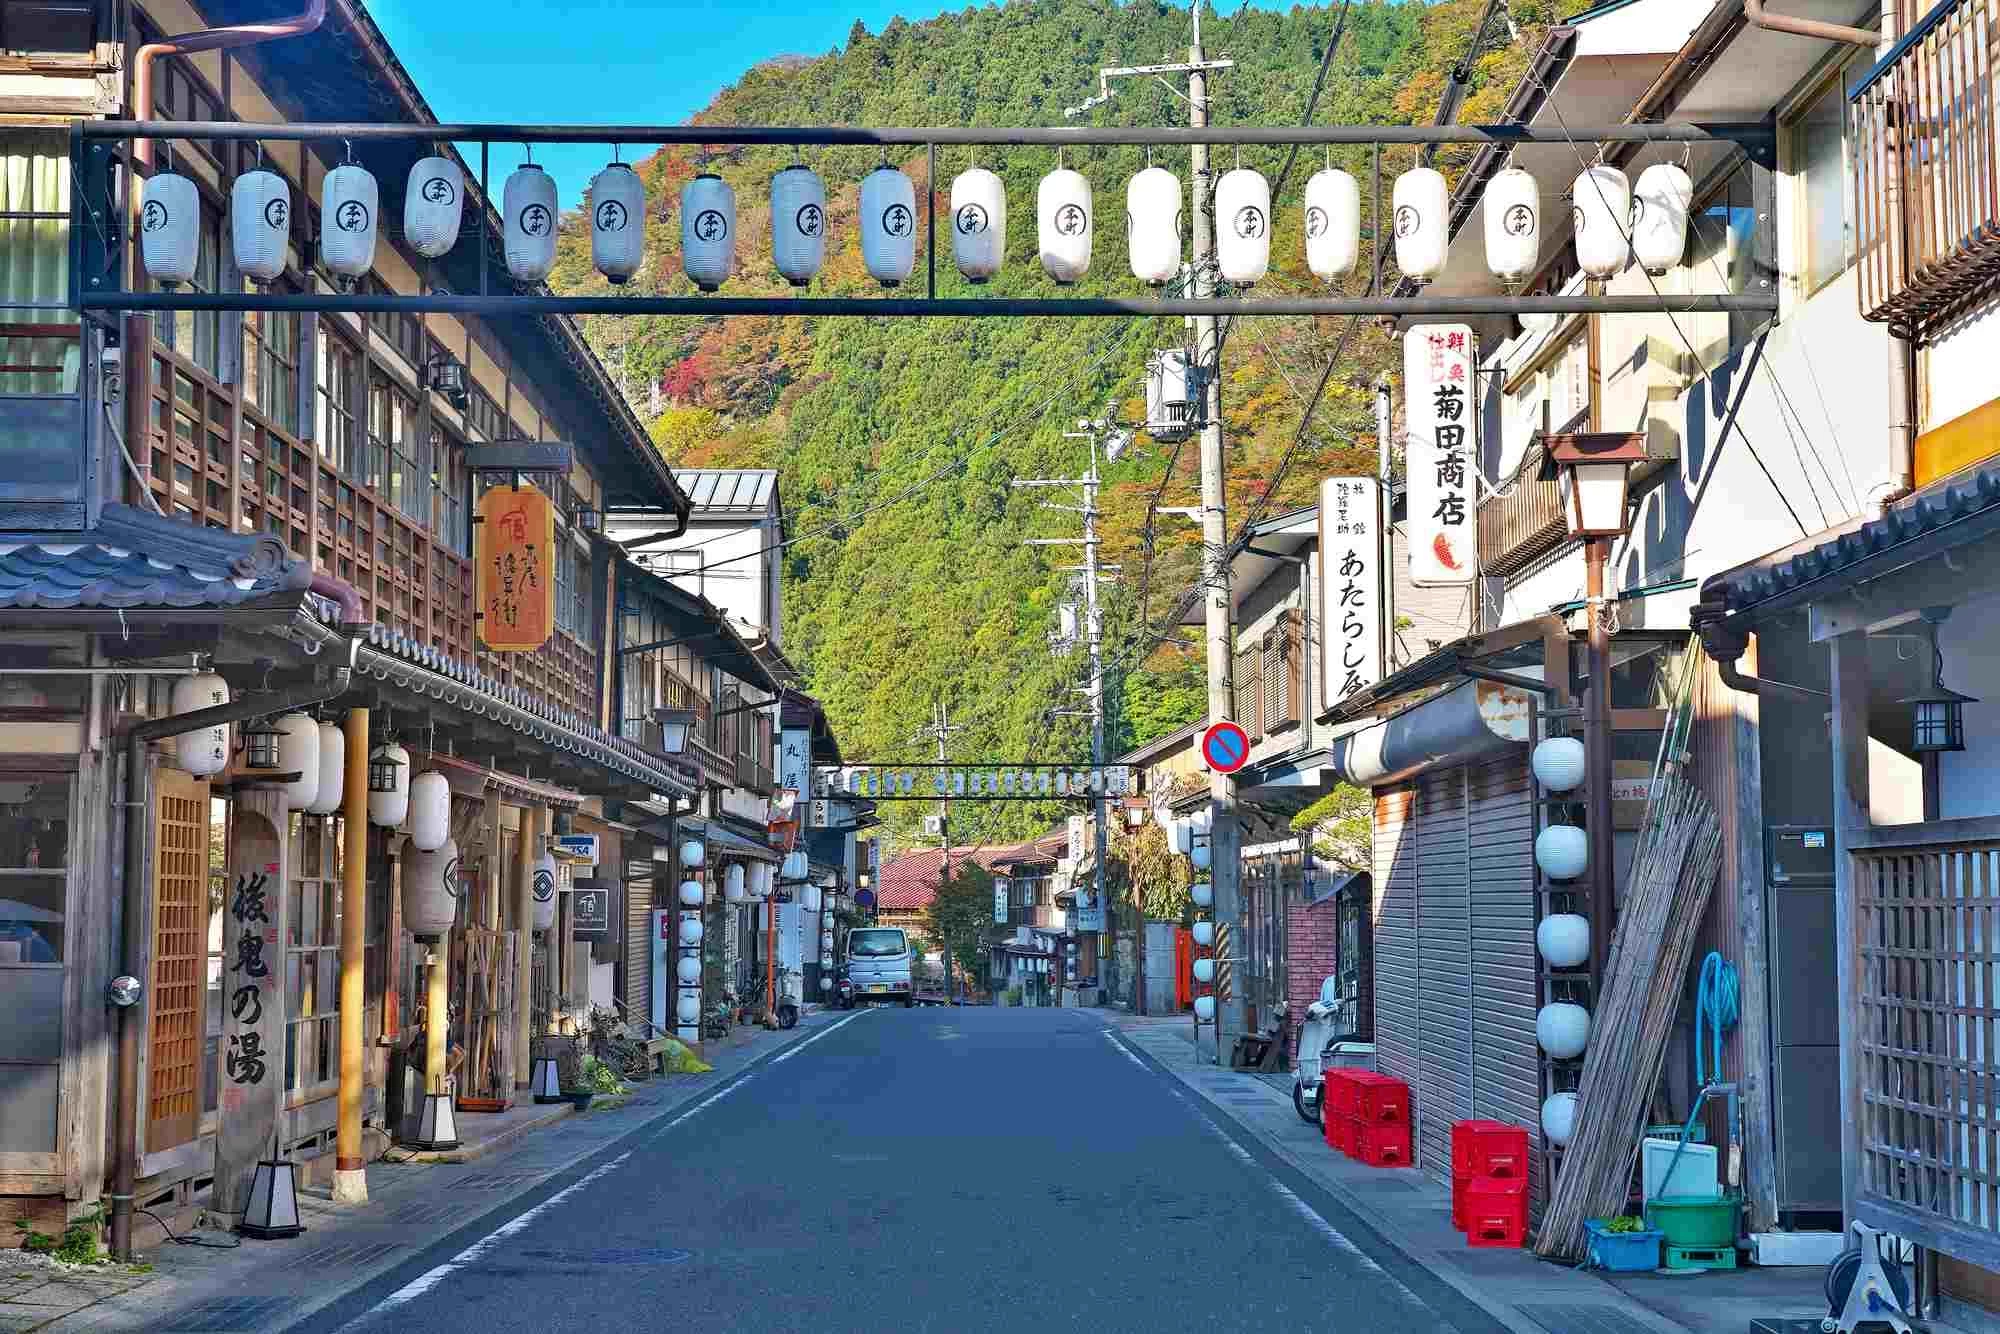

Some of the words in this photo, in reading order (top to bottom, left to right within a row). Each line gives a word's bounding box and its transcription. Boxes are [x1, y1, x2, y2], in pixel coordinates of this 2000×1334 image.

[1429, 332, 1445, 383] 仕出し
[1447, 332, 1465, 382] 鮮魚
[1433, 384, 1466, 525] 菊田商店
[1338, 549, 1370, 697] あたらし屋
[226, 872, 269, 1085] 後鬼の湯
